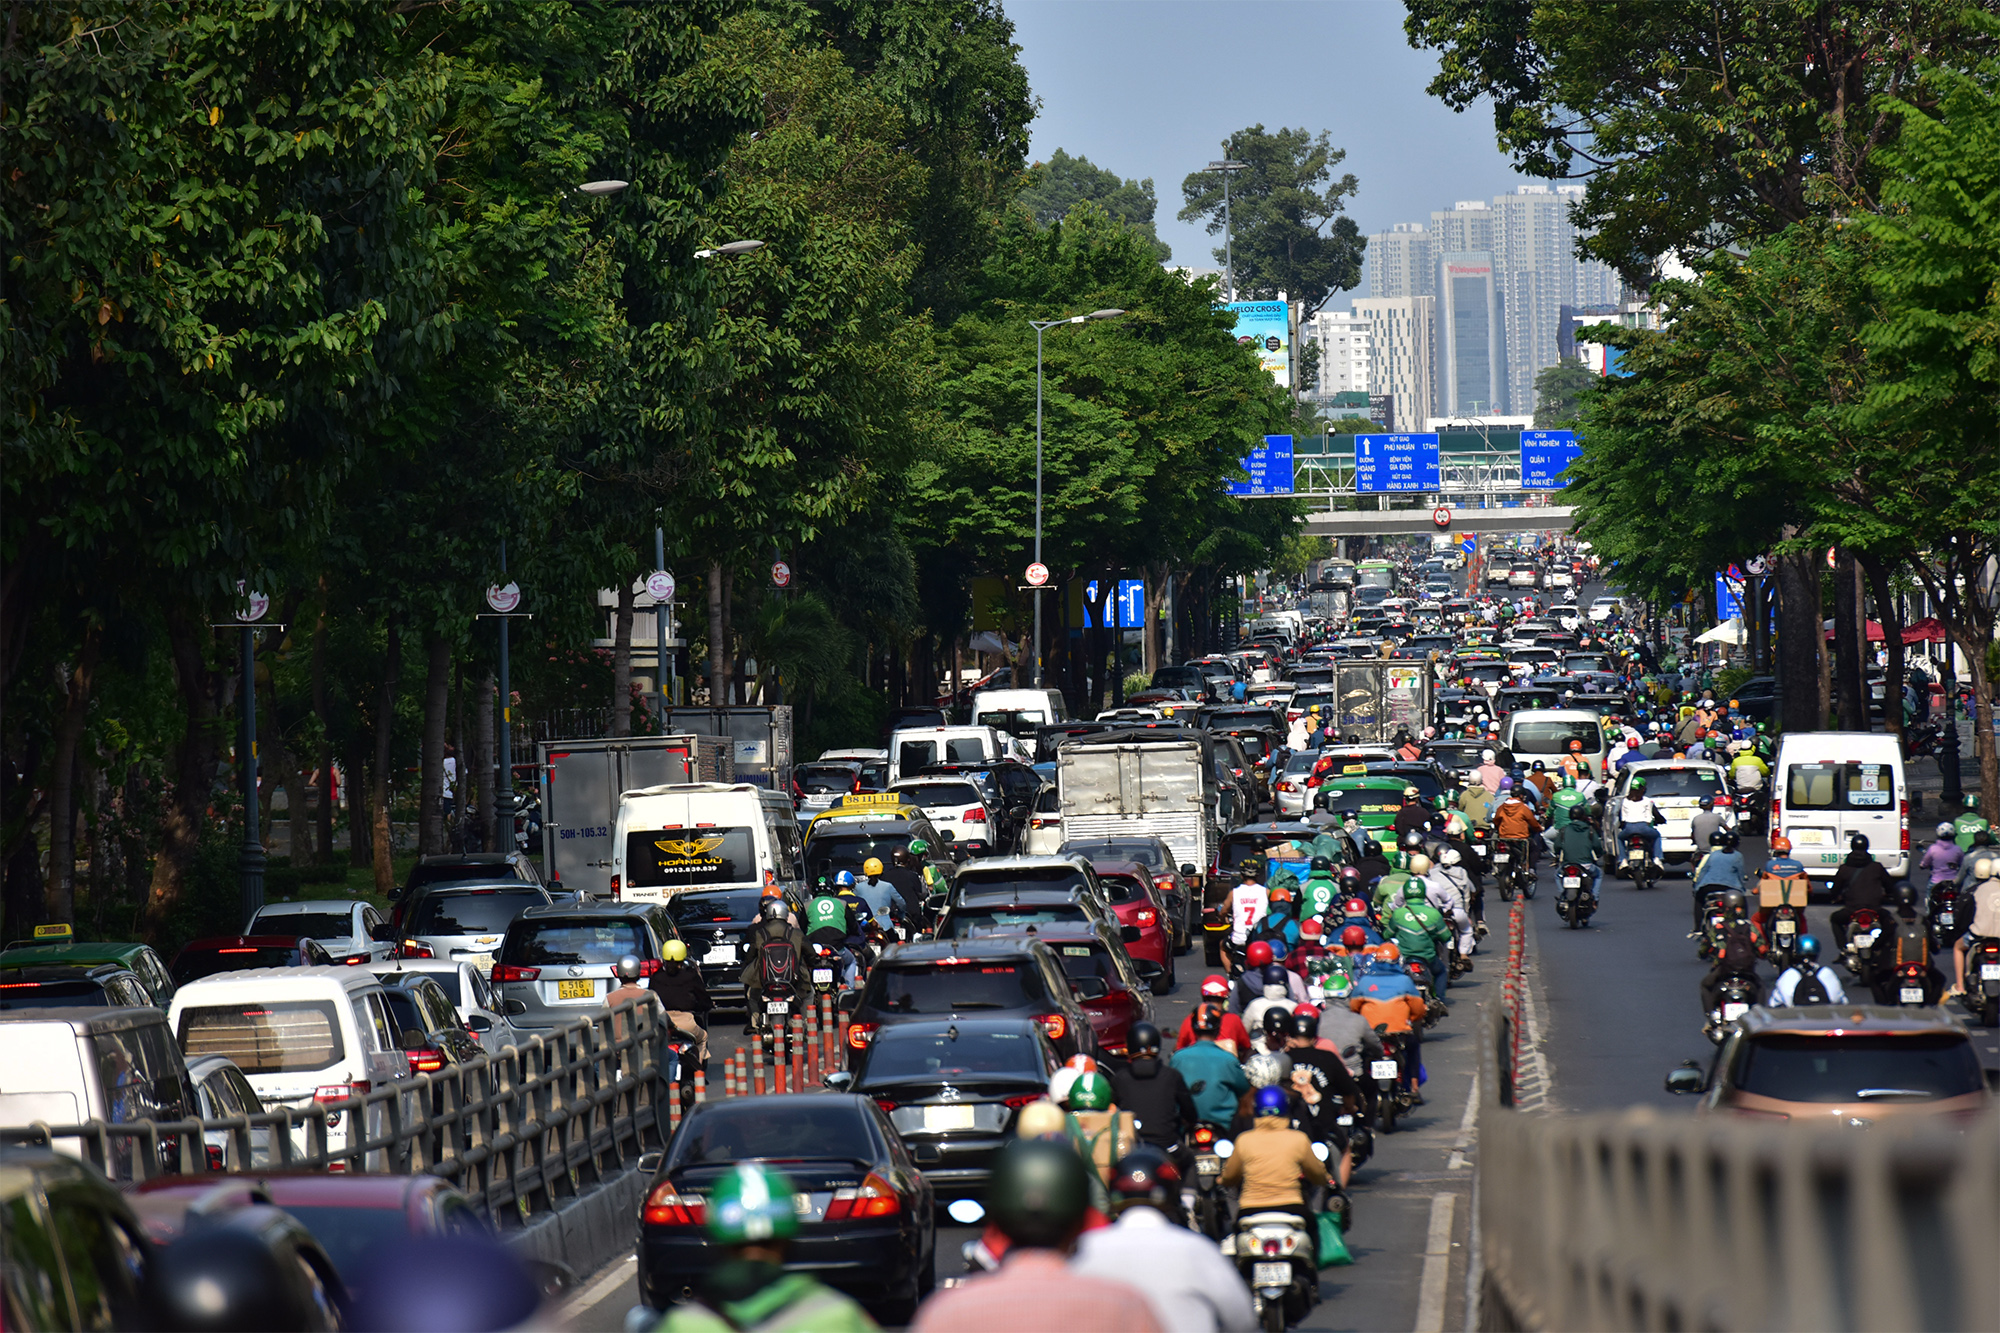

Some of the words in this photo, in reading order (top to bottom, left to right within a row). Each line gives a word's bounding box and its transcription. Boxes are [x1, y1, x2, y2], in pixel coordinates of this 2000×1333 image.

[1358, 464, 1376, 472] HOÀNG
[1386, 481, 1402, 489] HÀNG
[1391, 677, 1416, 688] VTT
[658, 858, 702, 866] HOÀNG
[704, 856, 722, 864] VŨ
[1244, 907, 1256, 926] 7
